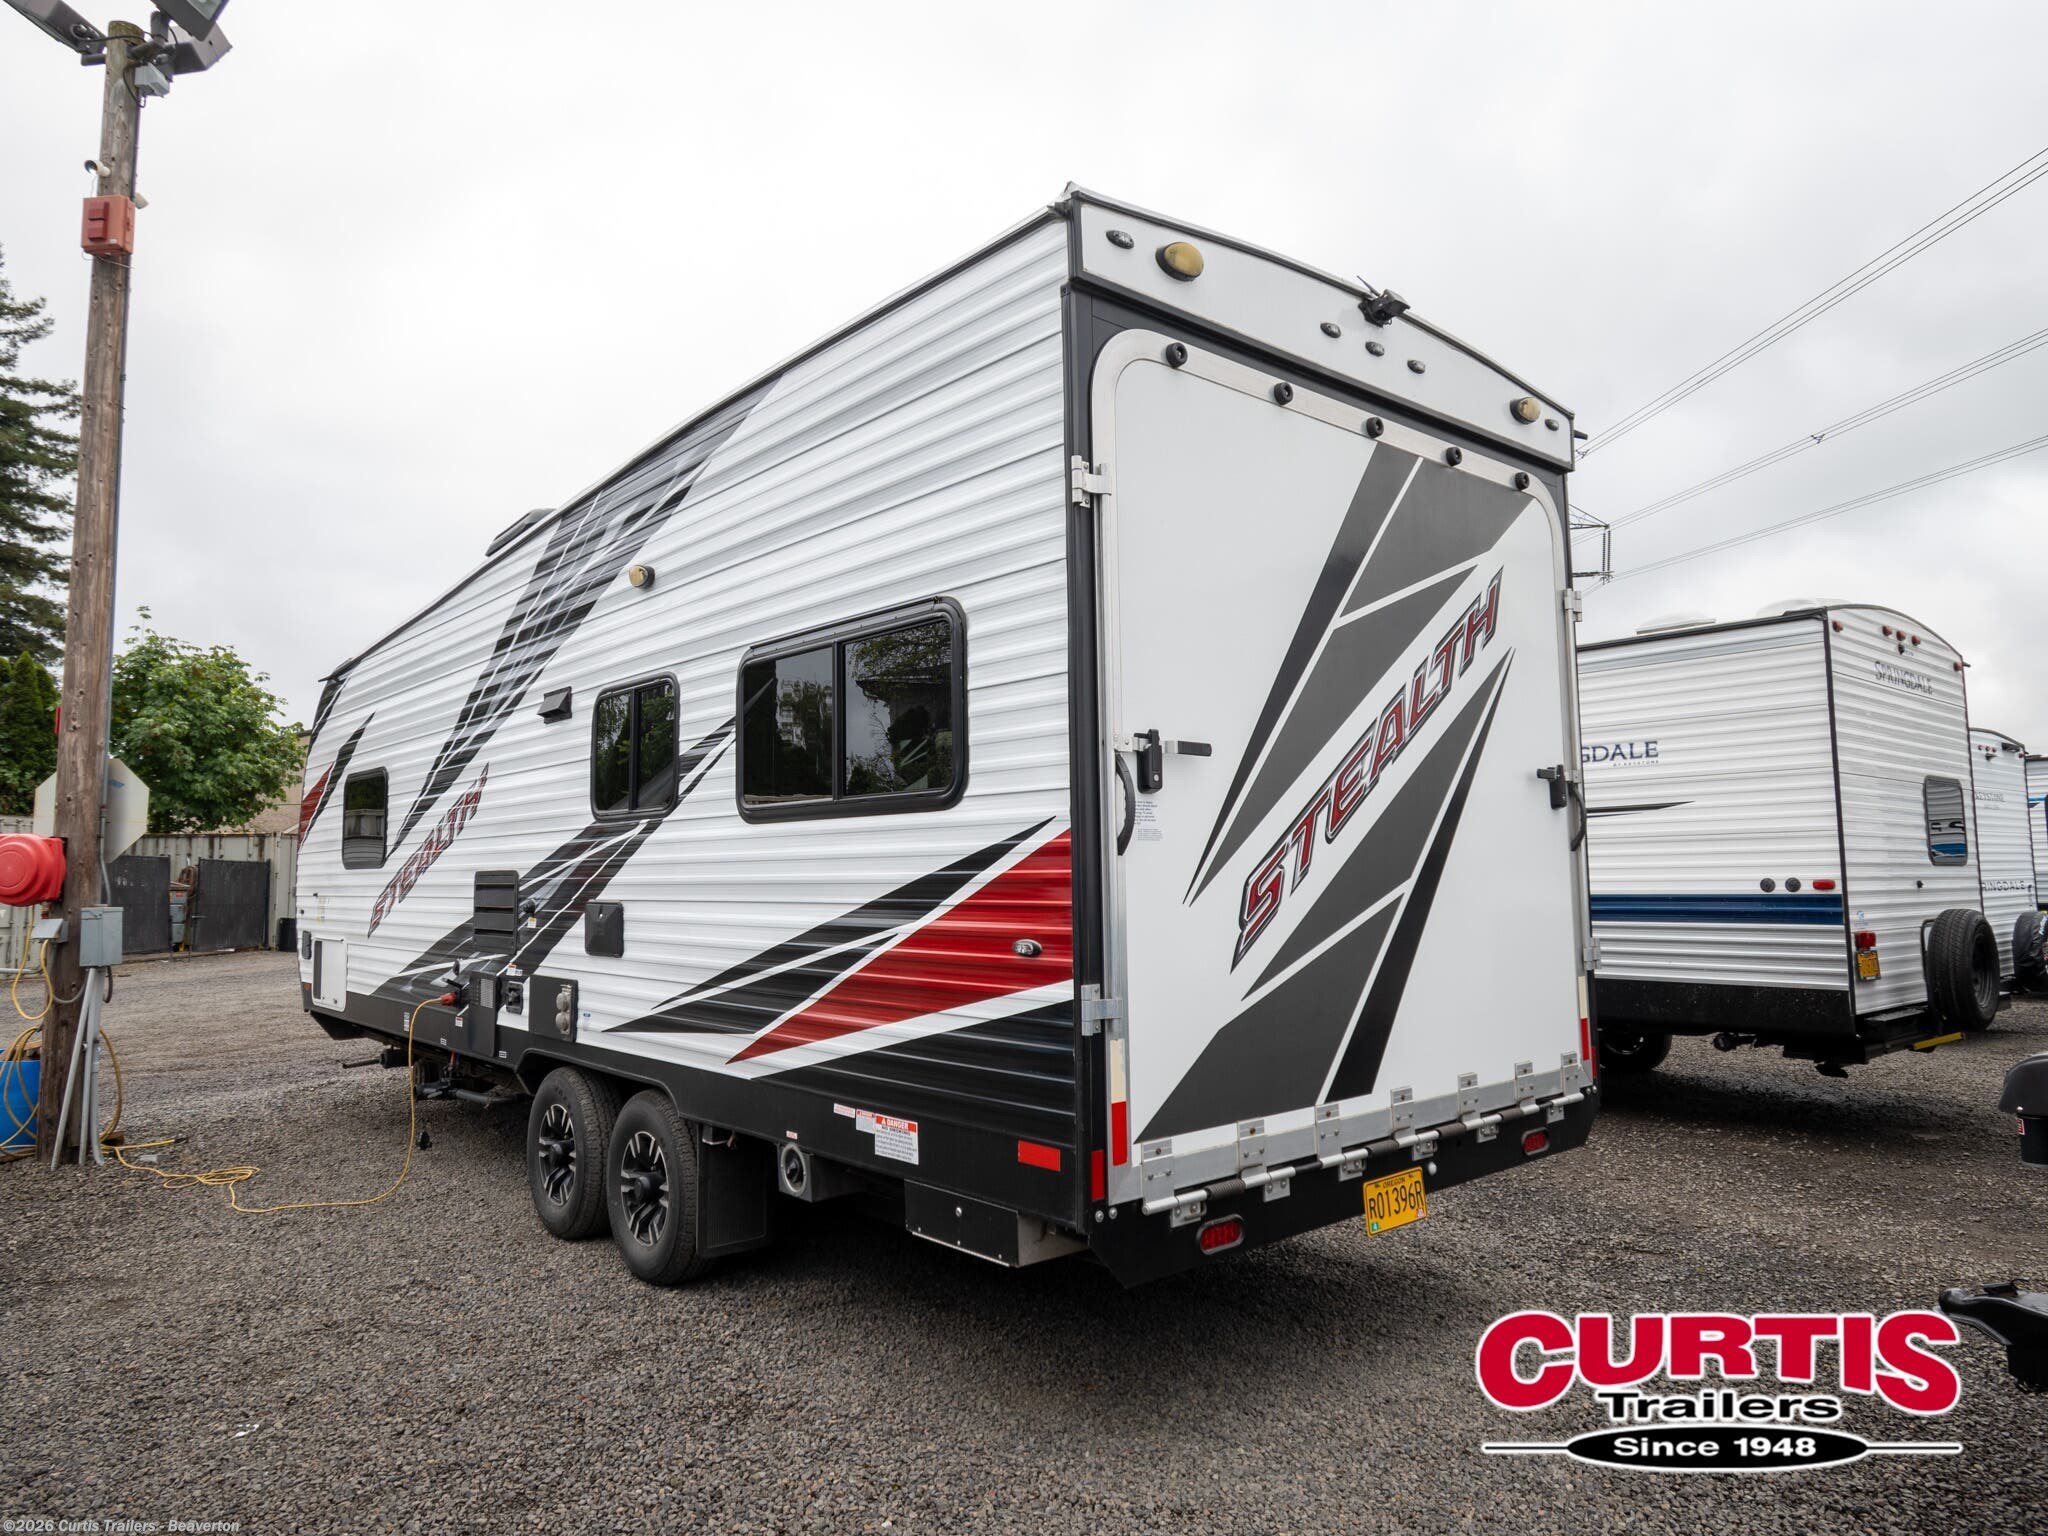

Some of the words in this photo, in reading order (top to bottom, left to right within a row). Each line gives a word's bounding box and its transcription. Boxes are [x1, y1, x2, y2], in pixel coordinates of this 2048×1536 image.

[1874, 661, 1933, 695] SPRINGDALE
[1230, 564, 1504, 975] STEALTH
[368, 762, 489, 938] STEALTH
[886, 1118, 909, 1130] DANGER
